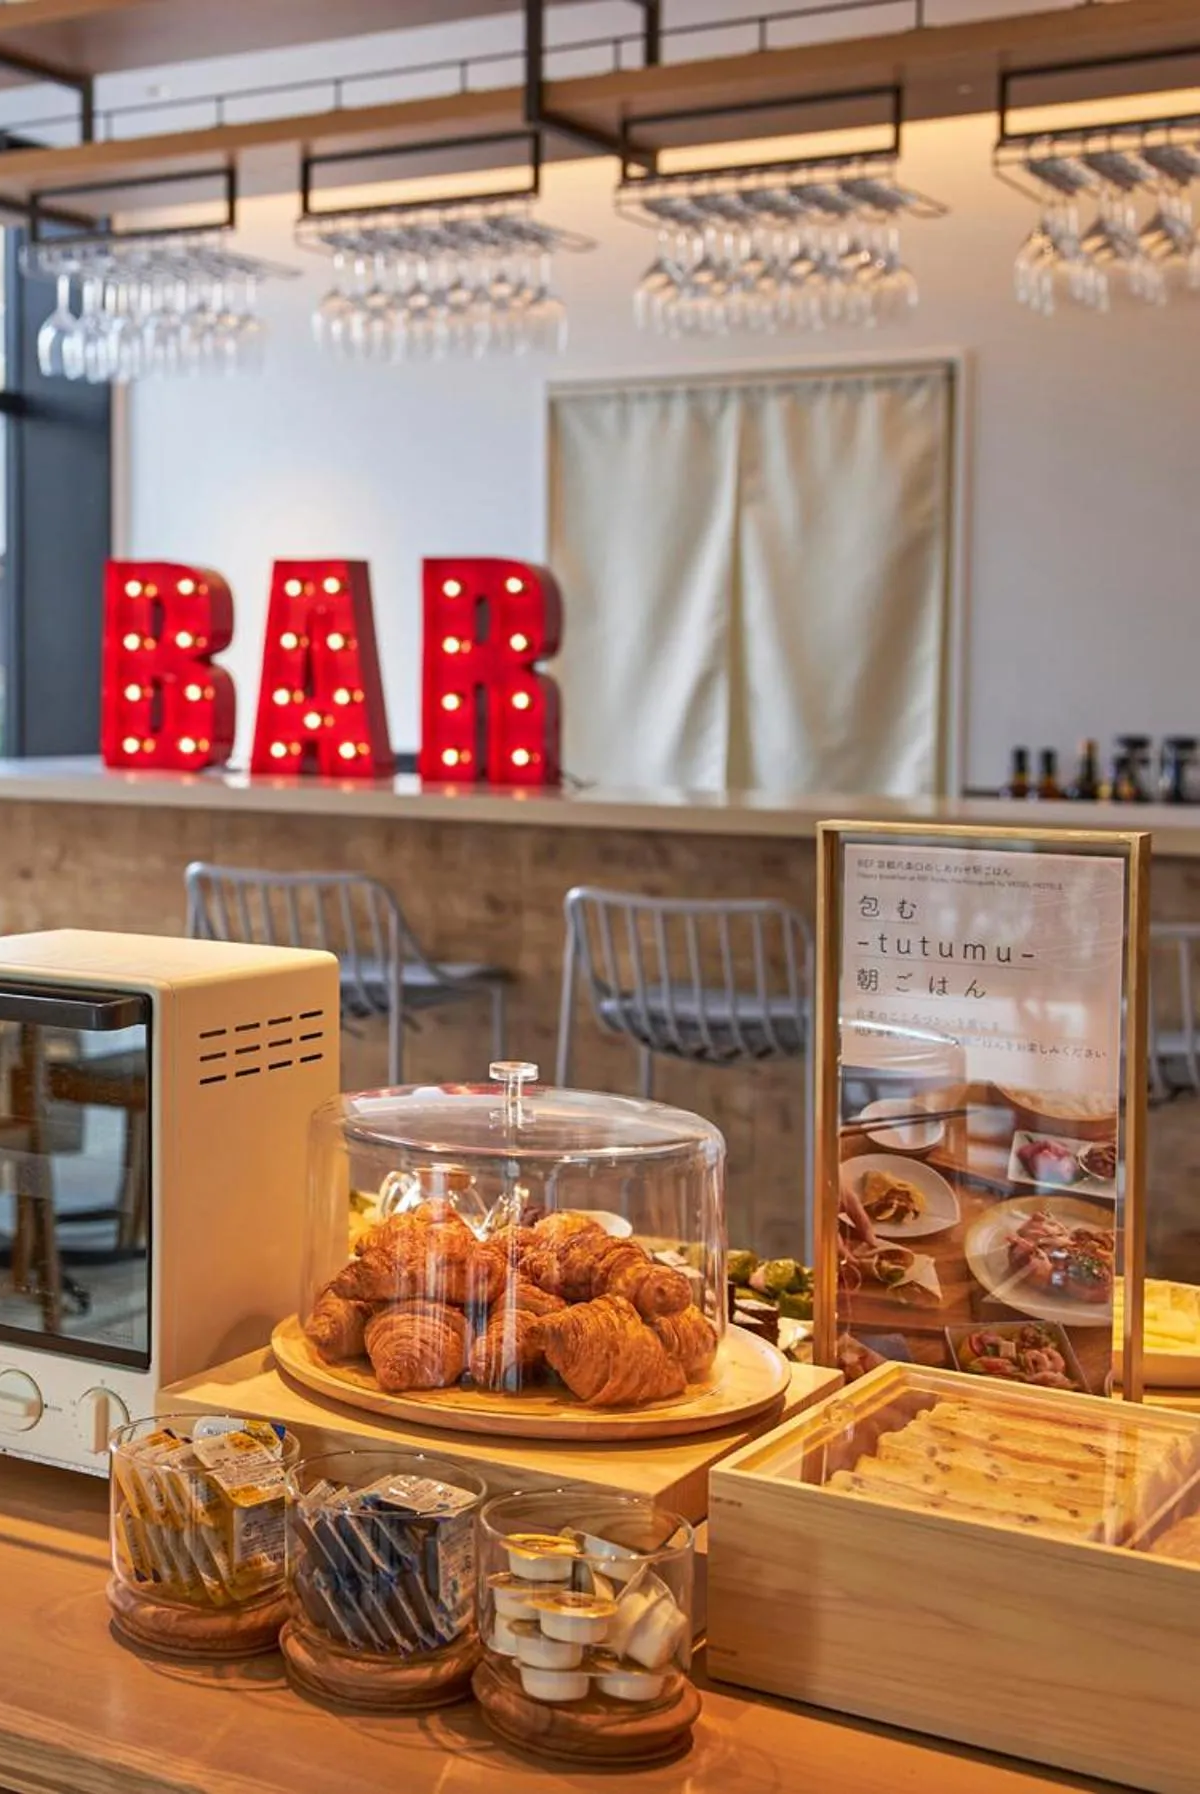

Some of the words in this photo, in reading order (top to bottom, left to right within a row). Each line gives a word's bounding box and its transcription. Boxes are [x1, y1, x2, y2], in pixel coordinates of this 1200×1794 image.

[102, 557, 564, 787] BAR
[859, 896, 917, 919] 包む
[857, 933, 1035, 963] -tutumu-
[857, 969, 986, 999] 朝ごはん
